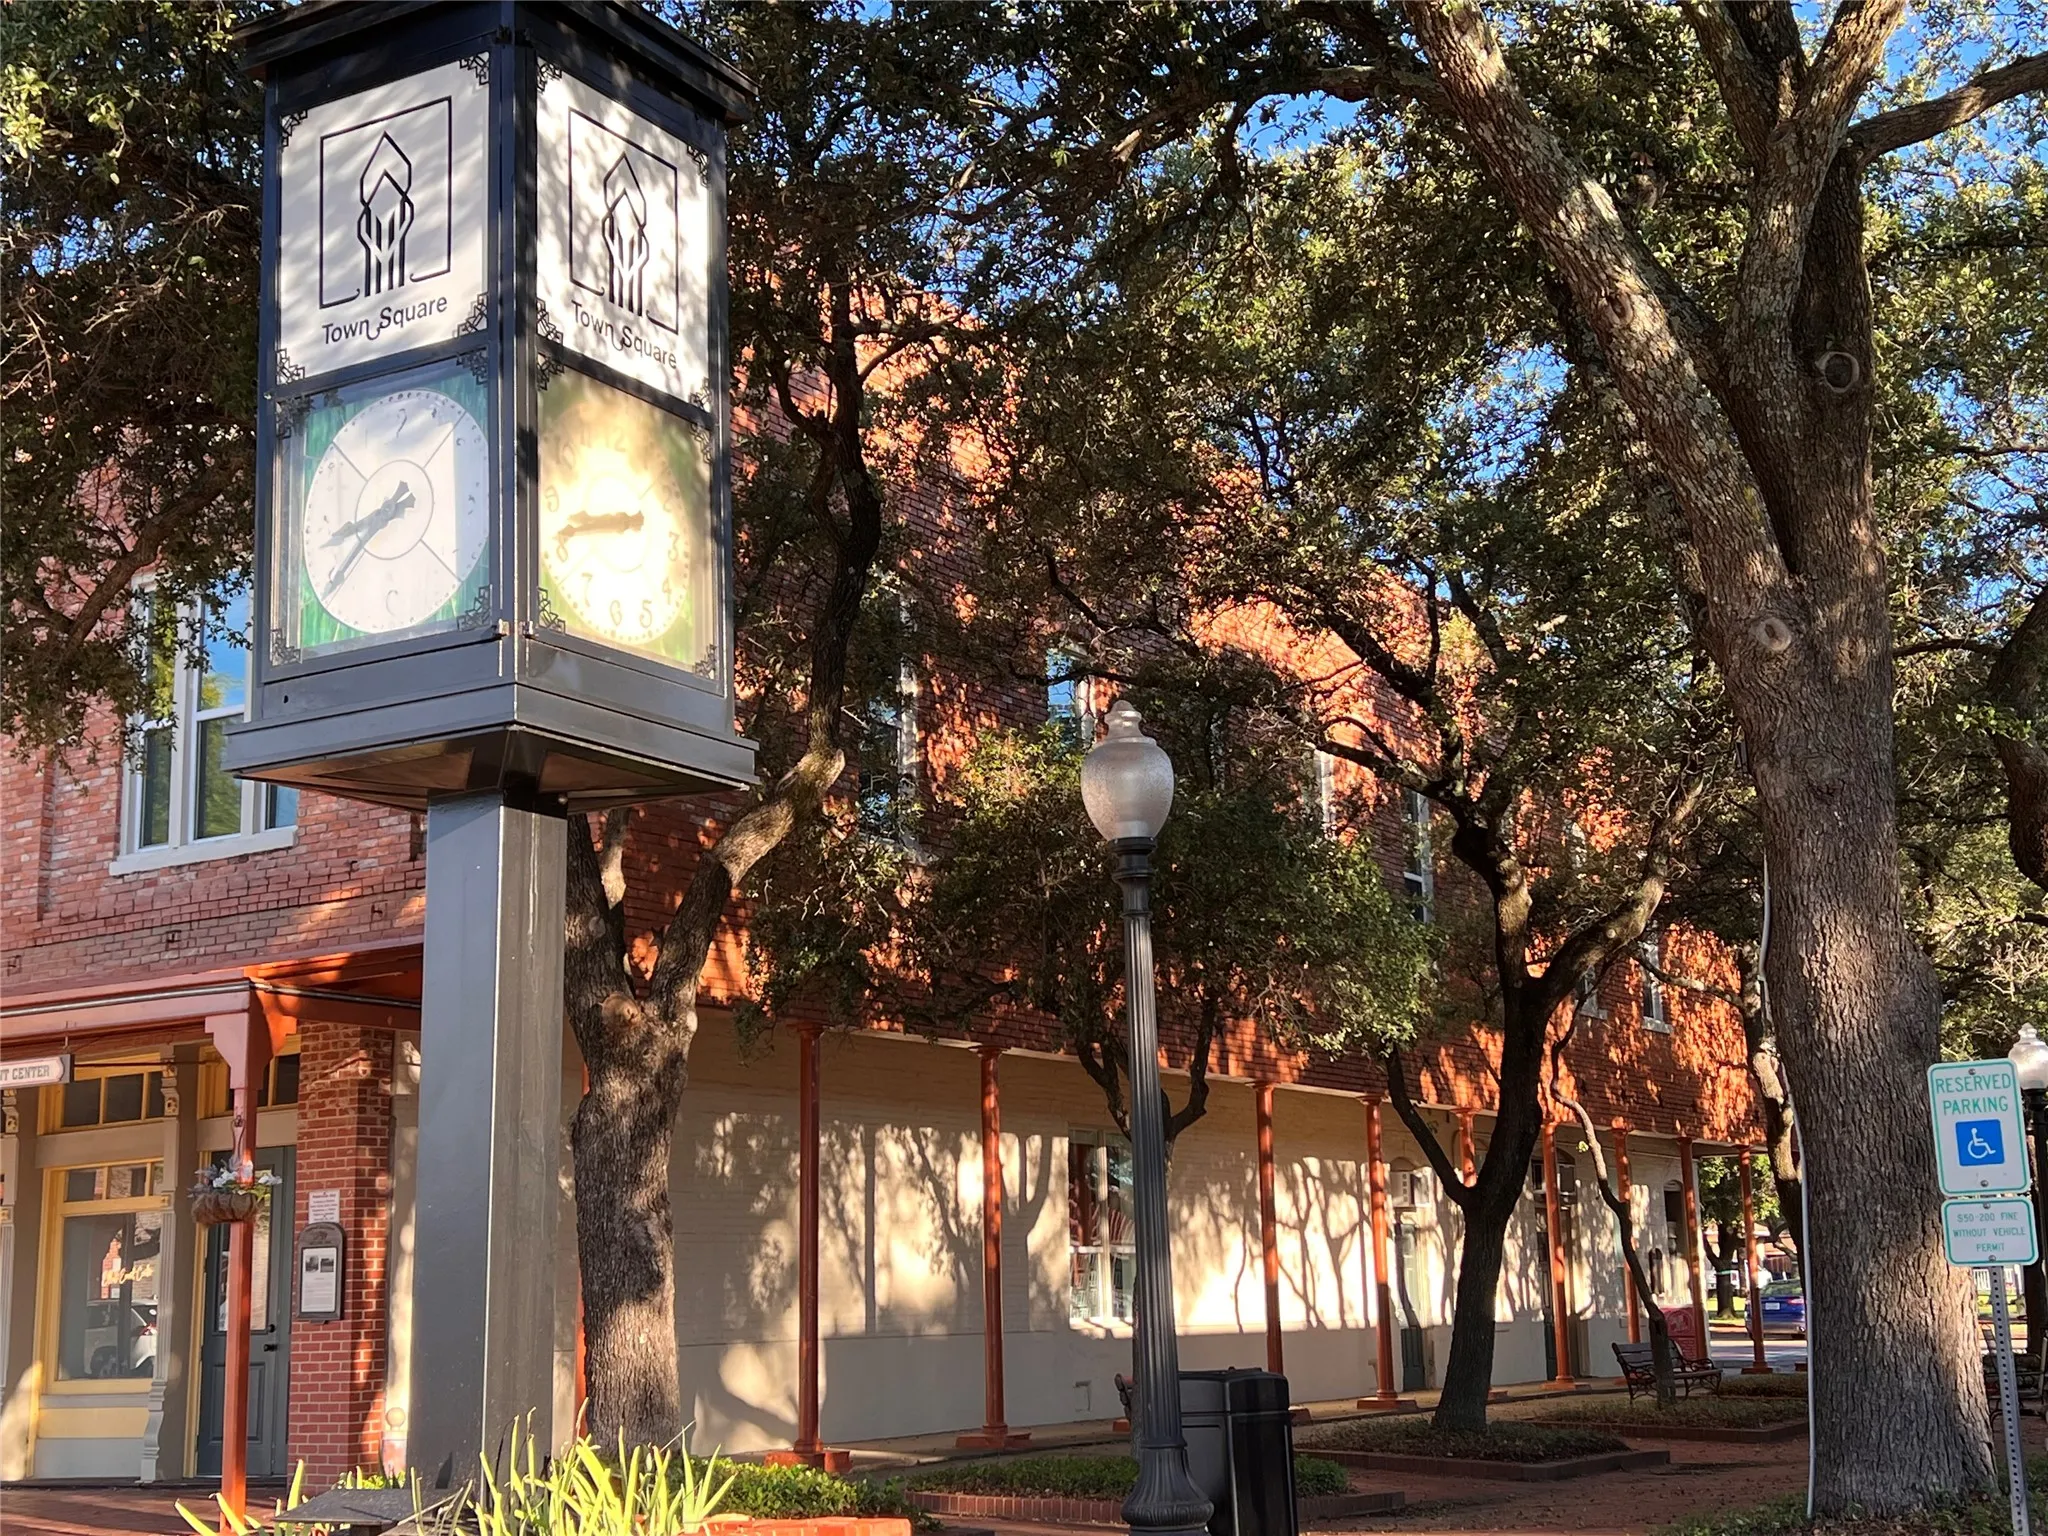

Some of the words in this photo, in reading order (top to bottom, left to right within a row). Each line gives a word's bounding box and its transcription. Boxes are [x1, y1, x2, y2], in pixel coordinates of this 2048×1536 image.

[322, 318, 380, 344] Town
[379, 296, 448, 328] Square
[571, 299, 624, 352] Town
[622, 325, 678, 370] Square
[545, 485, 560, 513] 9
[668, 531, 680, 562] 3
[582, 572, 594, 608] 7
[662, 577, 673, 605] 4
[609, 600, 623, 627] 6
[639, 599, 654, 629] 5
[12, 1065, 50, 1080] CENTER
[1935, 1073, 2012, 1094] RESERVED
[1943, 1096, 2009, 1116] PARKING
[2000, 1212, 2019, 1221] FINE
[1953, 1228, 1988, 1238] WITHOUT
[1993, 1226, 2026, 1237] VEHICLE
[1976, 1242, 2005, 1252] PERMIT
